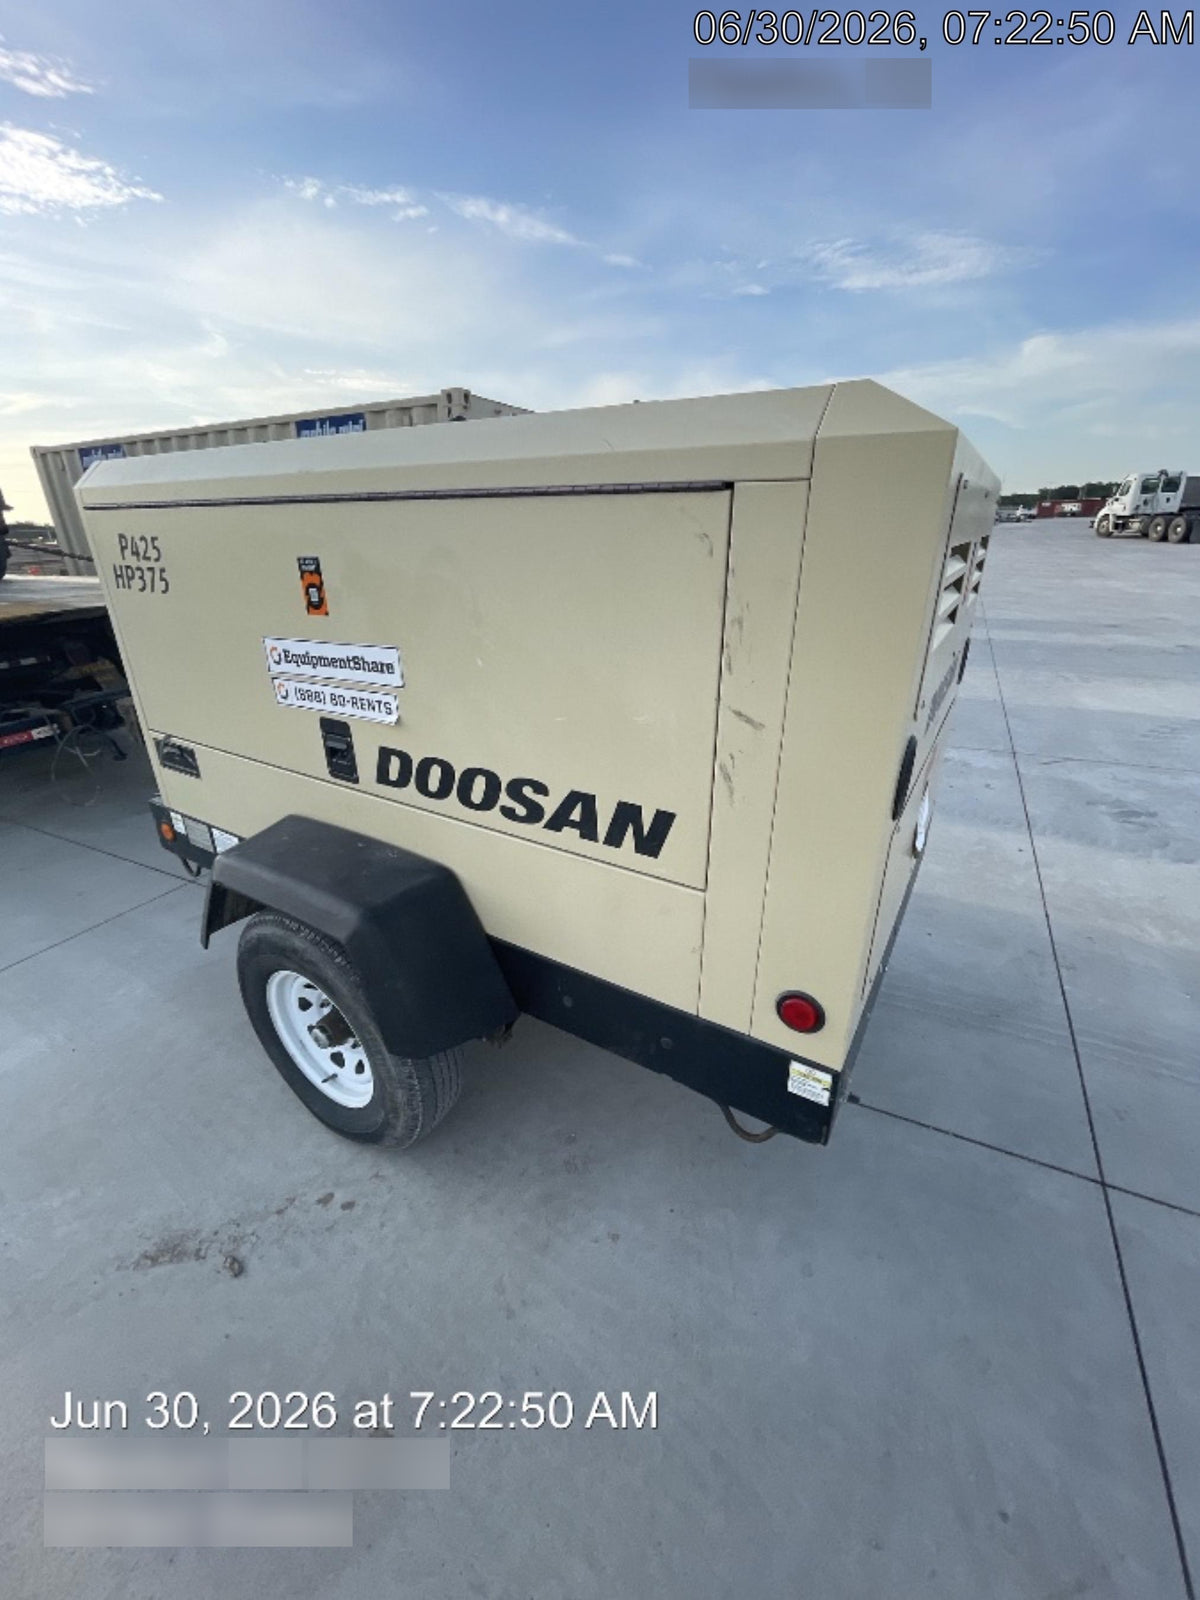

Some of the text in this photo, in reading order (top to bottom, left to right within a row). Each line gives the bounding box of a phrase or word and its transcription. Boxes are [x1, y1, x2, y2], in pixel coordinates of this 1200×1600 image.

[118, 533, 161, 562] P425
[113, 564, 169, 594] HP375
[282, 648, 395, 675] EquipmentShare
[376, 746, 677, 859] DOOSAN
